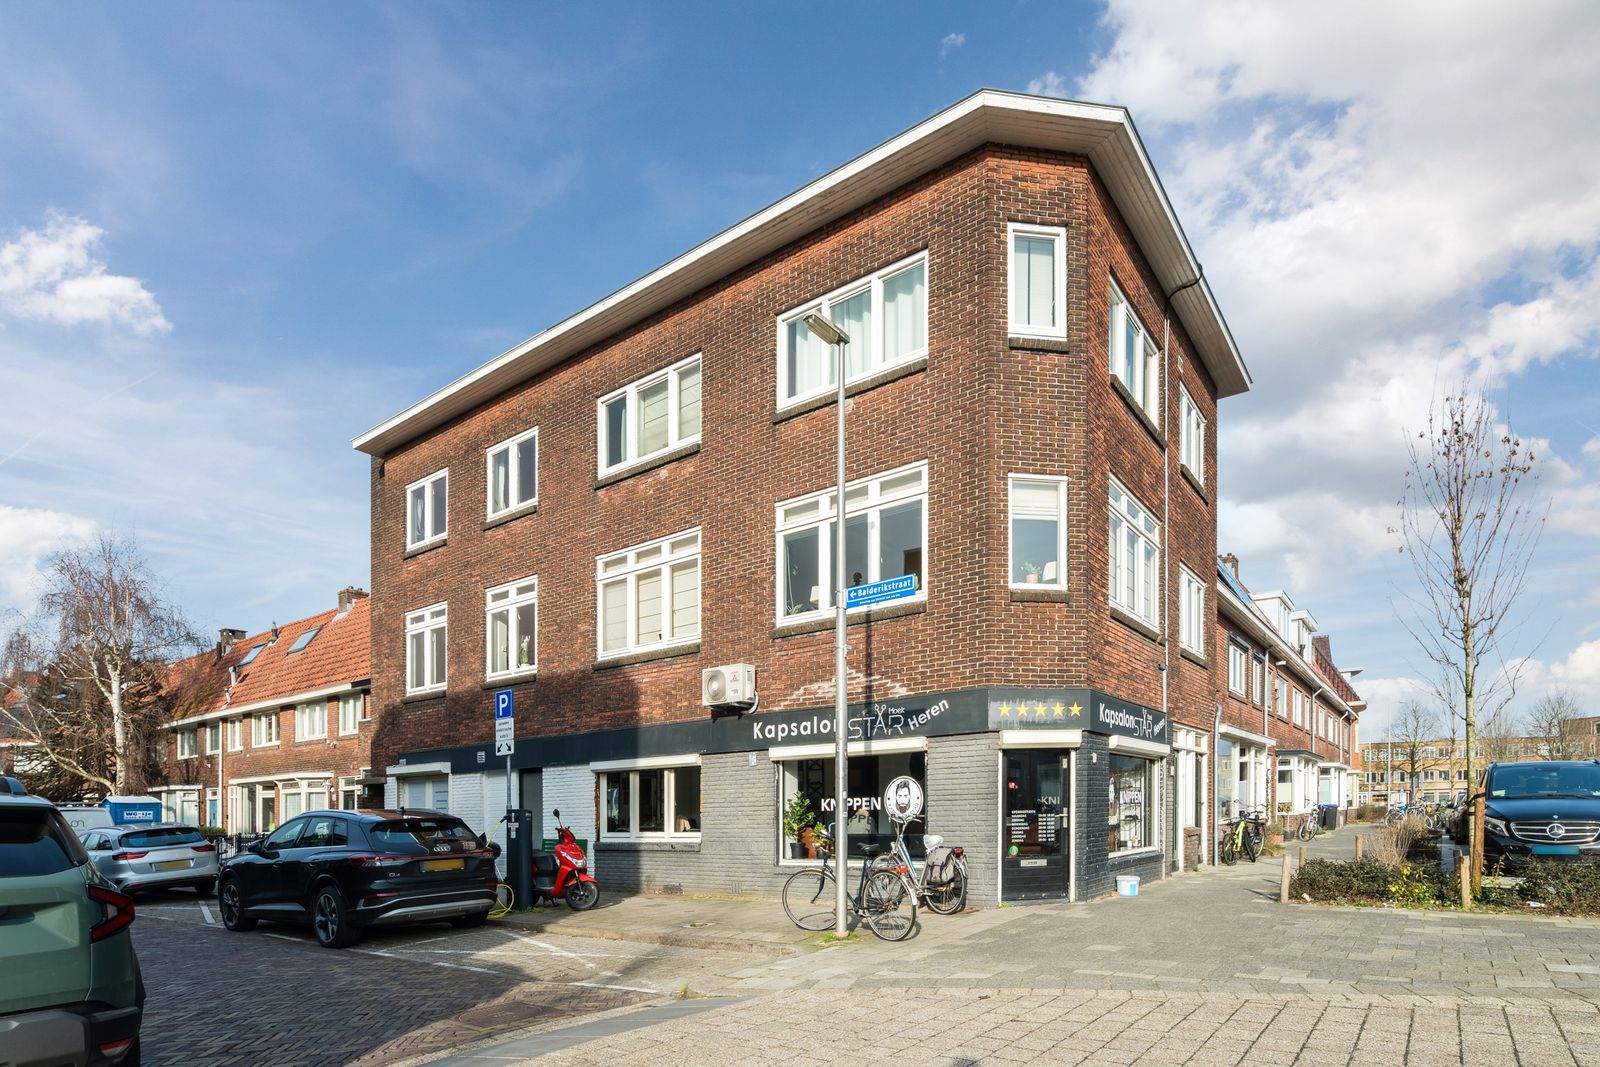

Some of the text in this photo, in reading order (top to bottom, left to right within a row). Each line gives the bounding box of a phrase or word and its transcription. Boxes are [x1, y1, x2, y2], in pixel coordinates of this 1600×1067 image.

[857, 579, 911, 596] Balderikstraat
[499, 694, 509, 716] P
[888, 706, 905, 715] Hoek
[753, 700, 950, 742] Kapsalo STAR Heren
[1099, 702, 1135, 728] Kapsalon
[1133, 707, 1153, 739] STAR
[821, 797, 881, 812] KNPPEN
